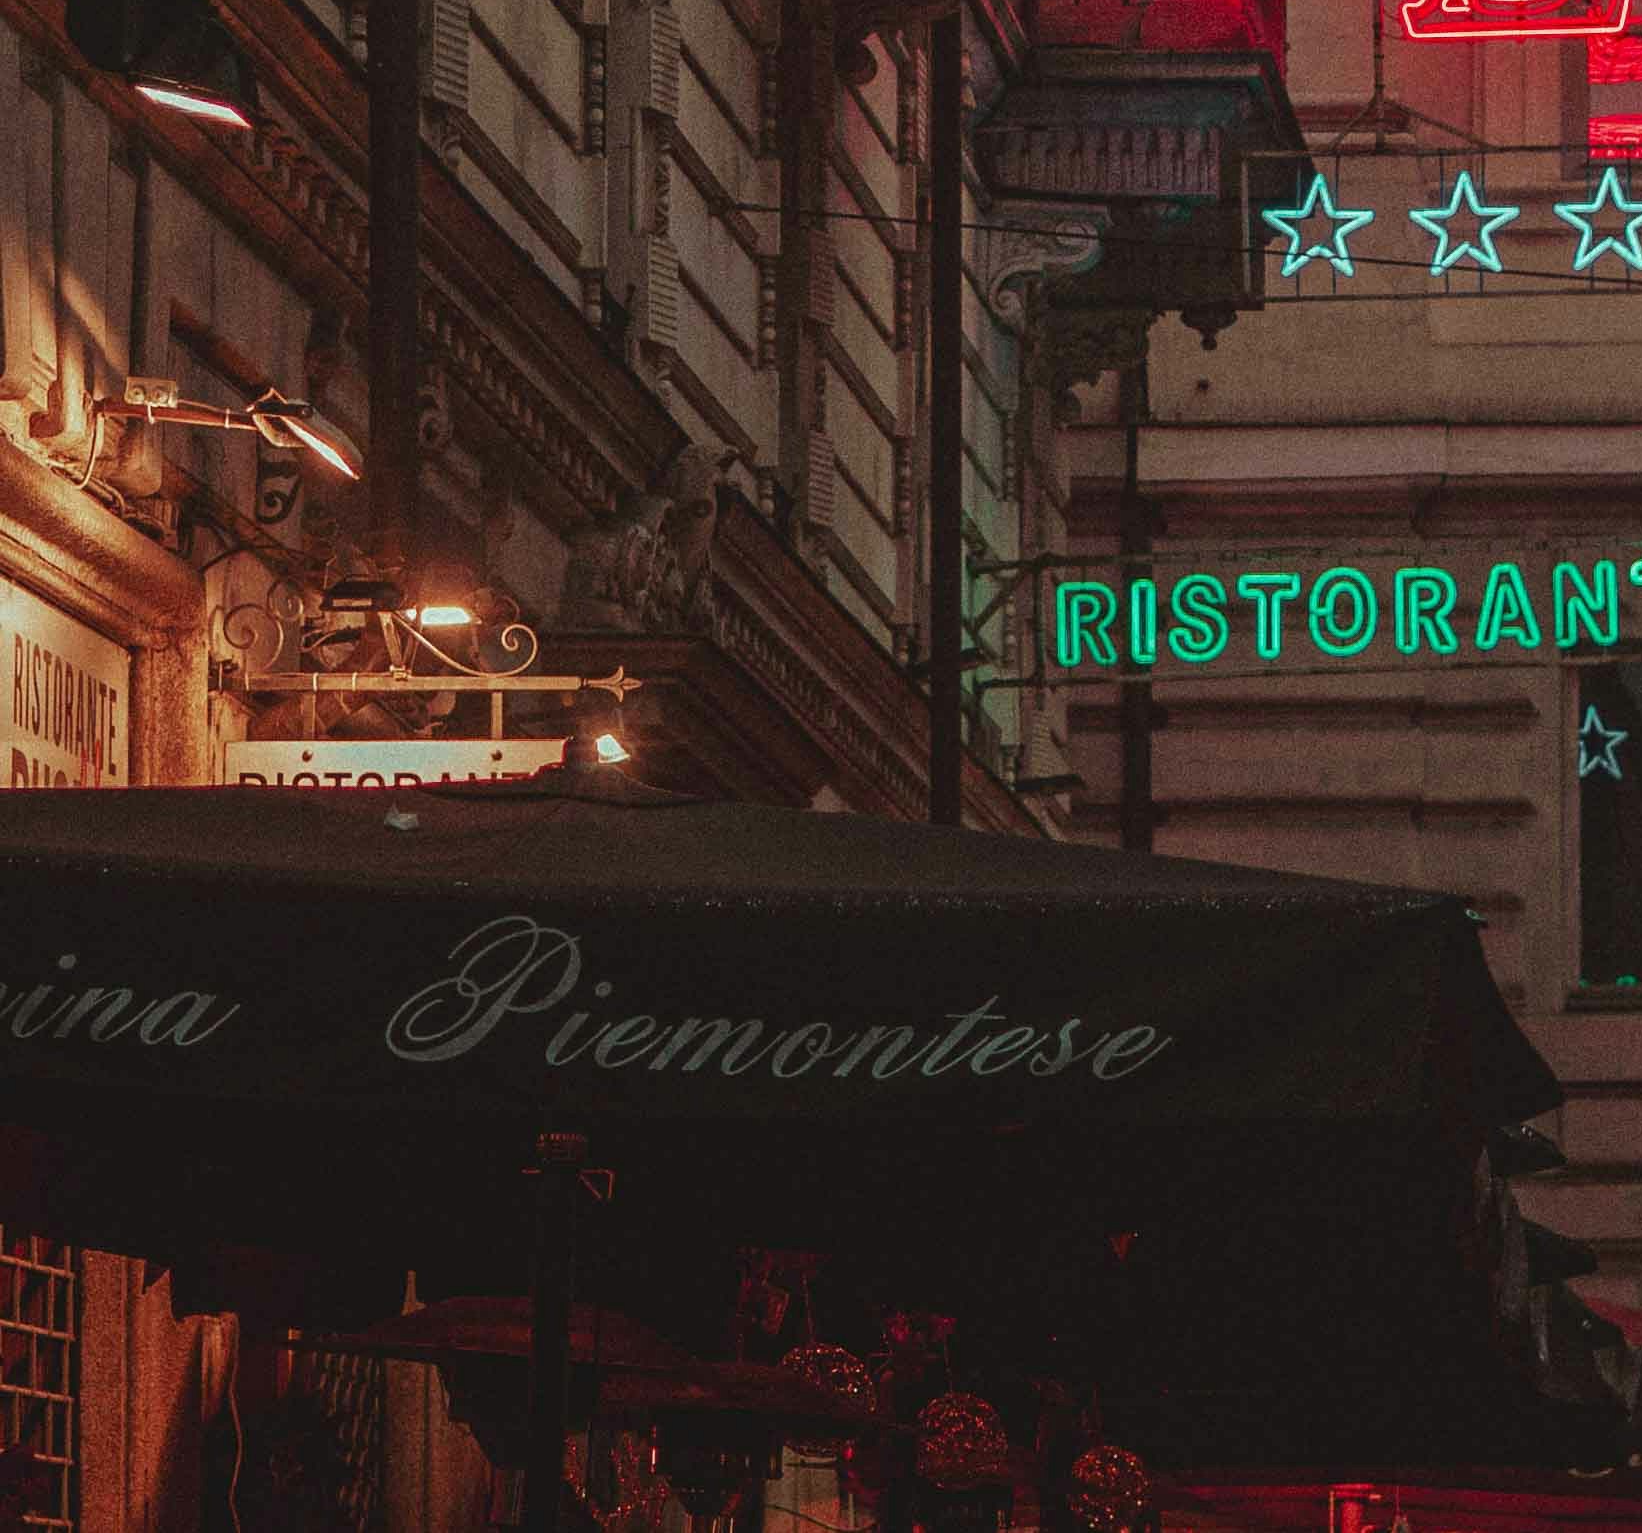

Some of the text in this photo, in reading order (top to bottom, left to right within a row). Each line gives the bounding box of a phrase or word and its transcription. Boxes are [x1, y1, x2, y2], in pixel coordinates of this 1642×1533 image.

[13, 633, 117, 776] RISTORANTE
[0, 914, 1173, 1080] ina Piemontese
